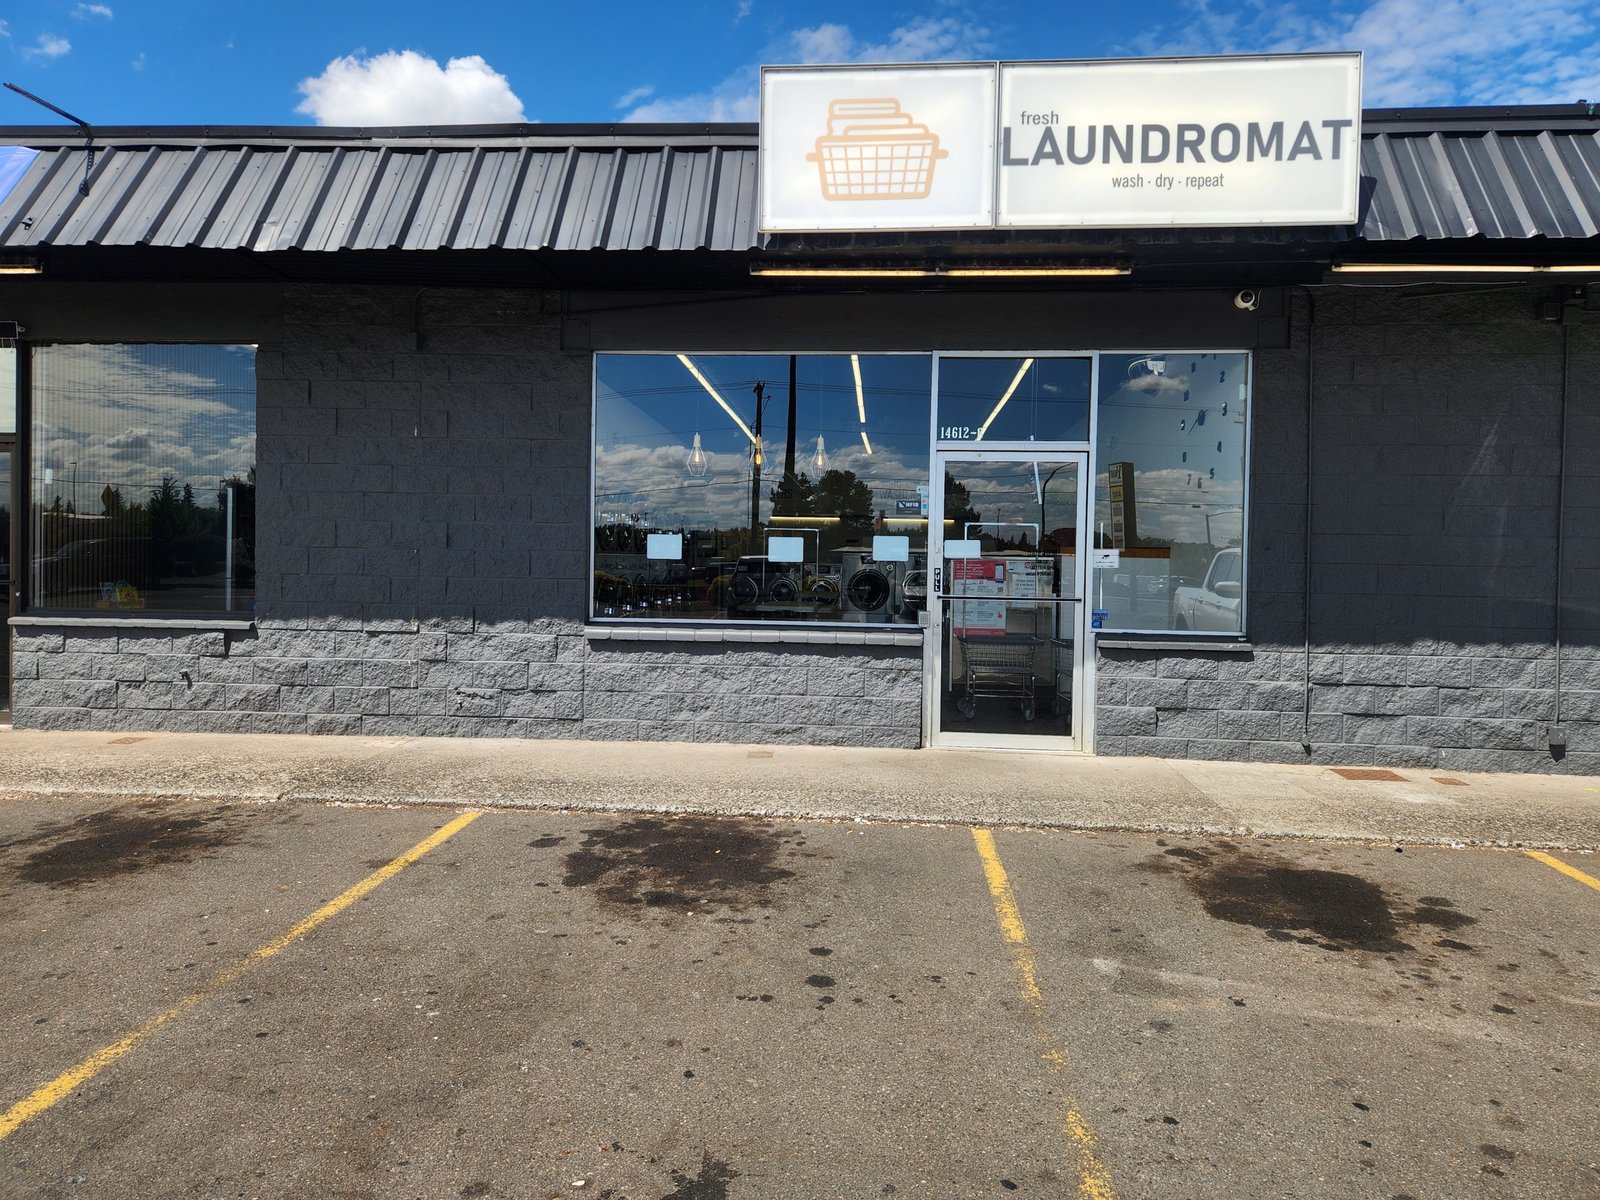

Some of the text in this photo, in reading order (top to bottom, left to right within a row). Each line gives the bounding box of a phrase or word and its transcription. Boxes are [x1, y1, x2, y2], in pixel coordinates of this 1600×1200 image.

[1021, 110, 1059, 126] fresh
[1003, 120, 1352, 166] LAUNDROMAT
[1113, 173, 1224, 191] wash dry repeat
